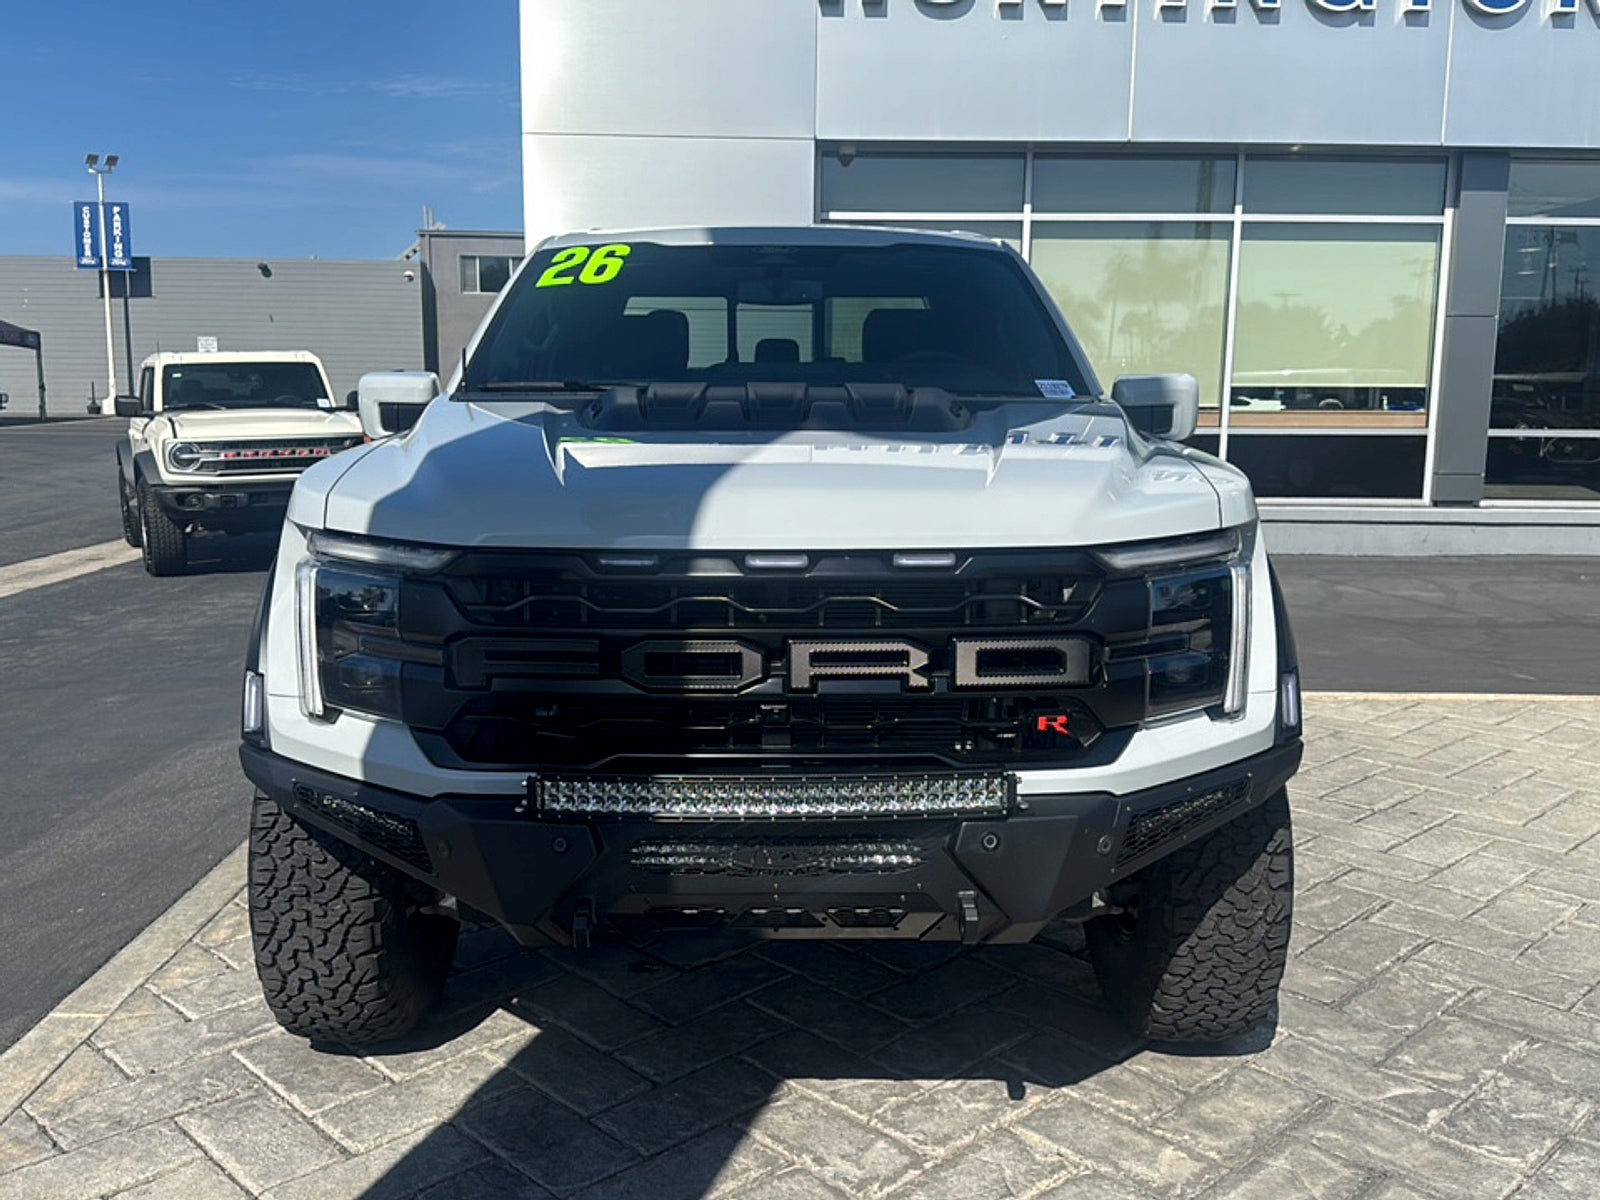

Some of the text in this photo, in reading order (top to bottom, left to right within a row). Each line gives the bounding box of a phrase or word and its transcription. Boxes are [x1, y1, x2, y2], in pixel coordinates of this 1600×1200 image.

[112, 206, 122, 258] PARKING
[535, 244, 632, 288] 26
[452, 637, 1094, 692] FORD
[1037, 715, 1069, 735] R
